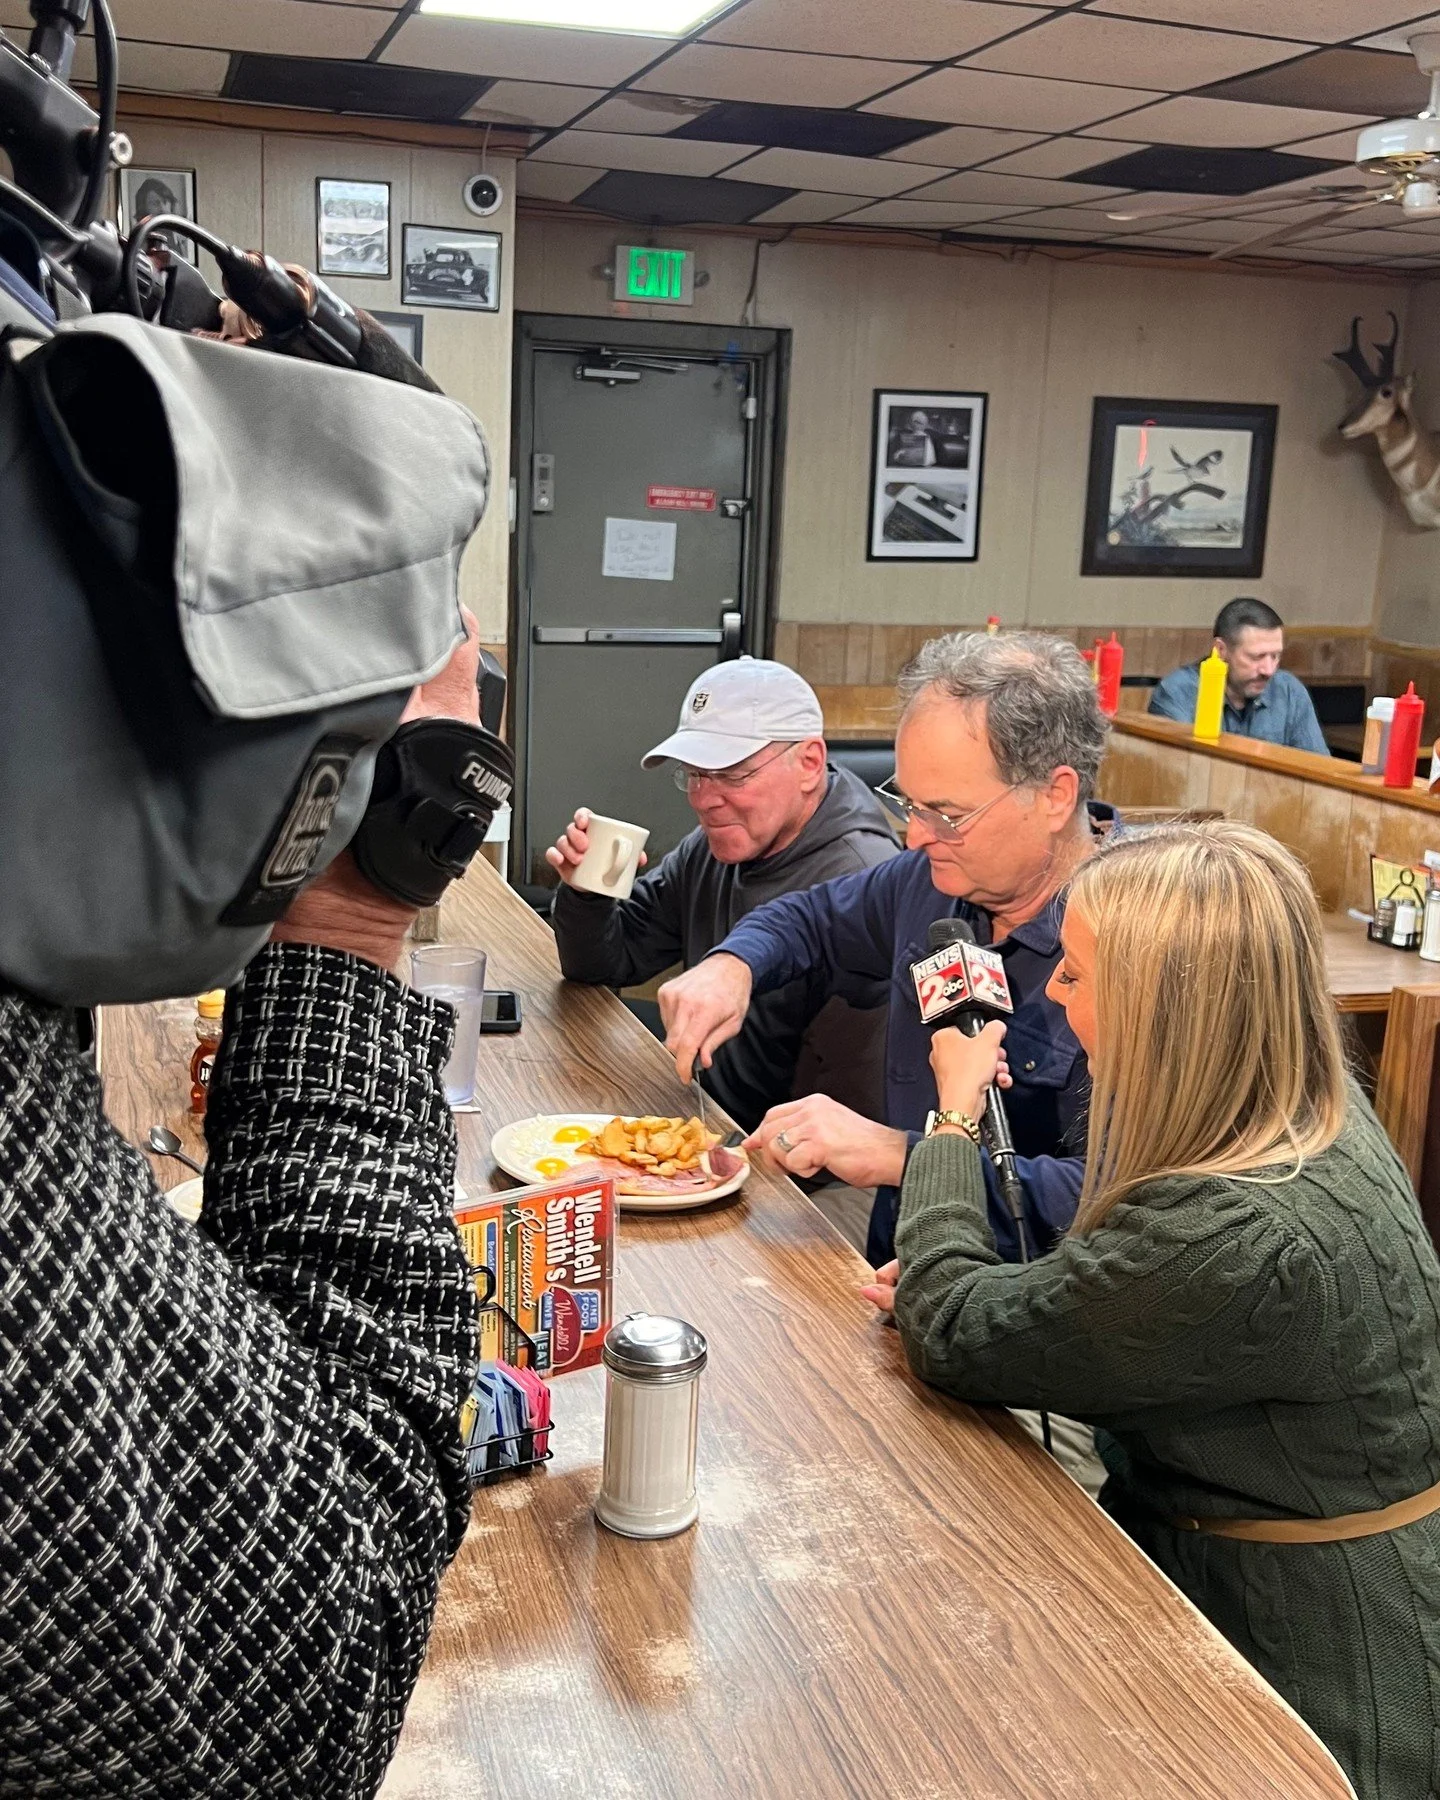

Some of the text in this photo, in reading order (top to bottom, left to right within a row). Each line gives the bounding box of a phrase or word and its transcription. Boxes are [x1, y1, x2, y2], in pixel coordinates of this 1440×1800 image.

[628, 246, 686, 299] EXIT
[915, 946, 960, 980] NEWS
[965, 946, 1002, 970] NEWS
[920, 975, 951, 1016] 2
[943, 977, 964, 998] abc
[545, 1196, 575, 1283] Smith's
[573, 1188, 602, 1285] Wendell
[506, 1207, 546, 1311] Restaurant
[581, 1296, 590, 1327] FOOD
[590, 1296, 598, 1325] FINE
[536, 1343, 548, 1367] EAT
